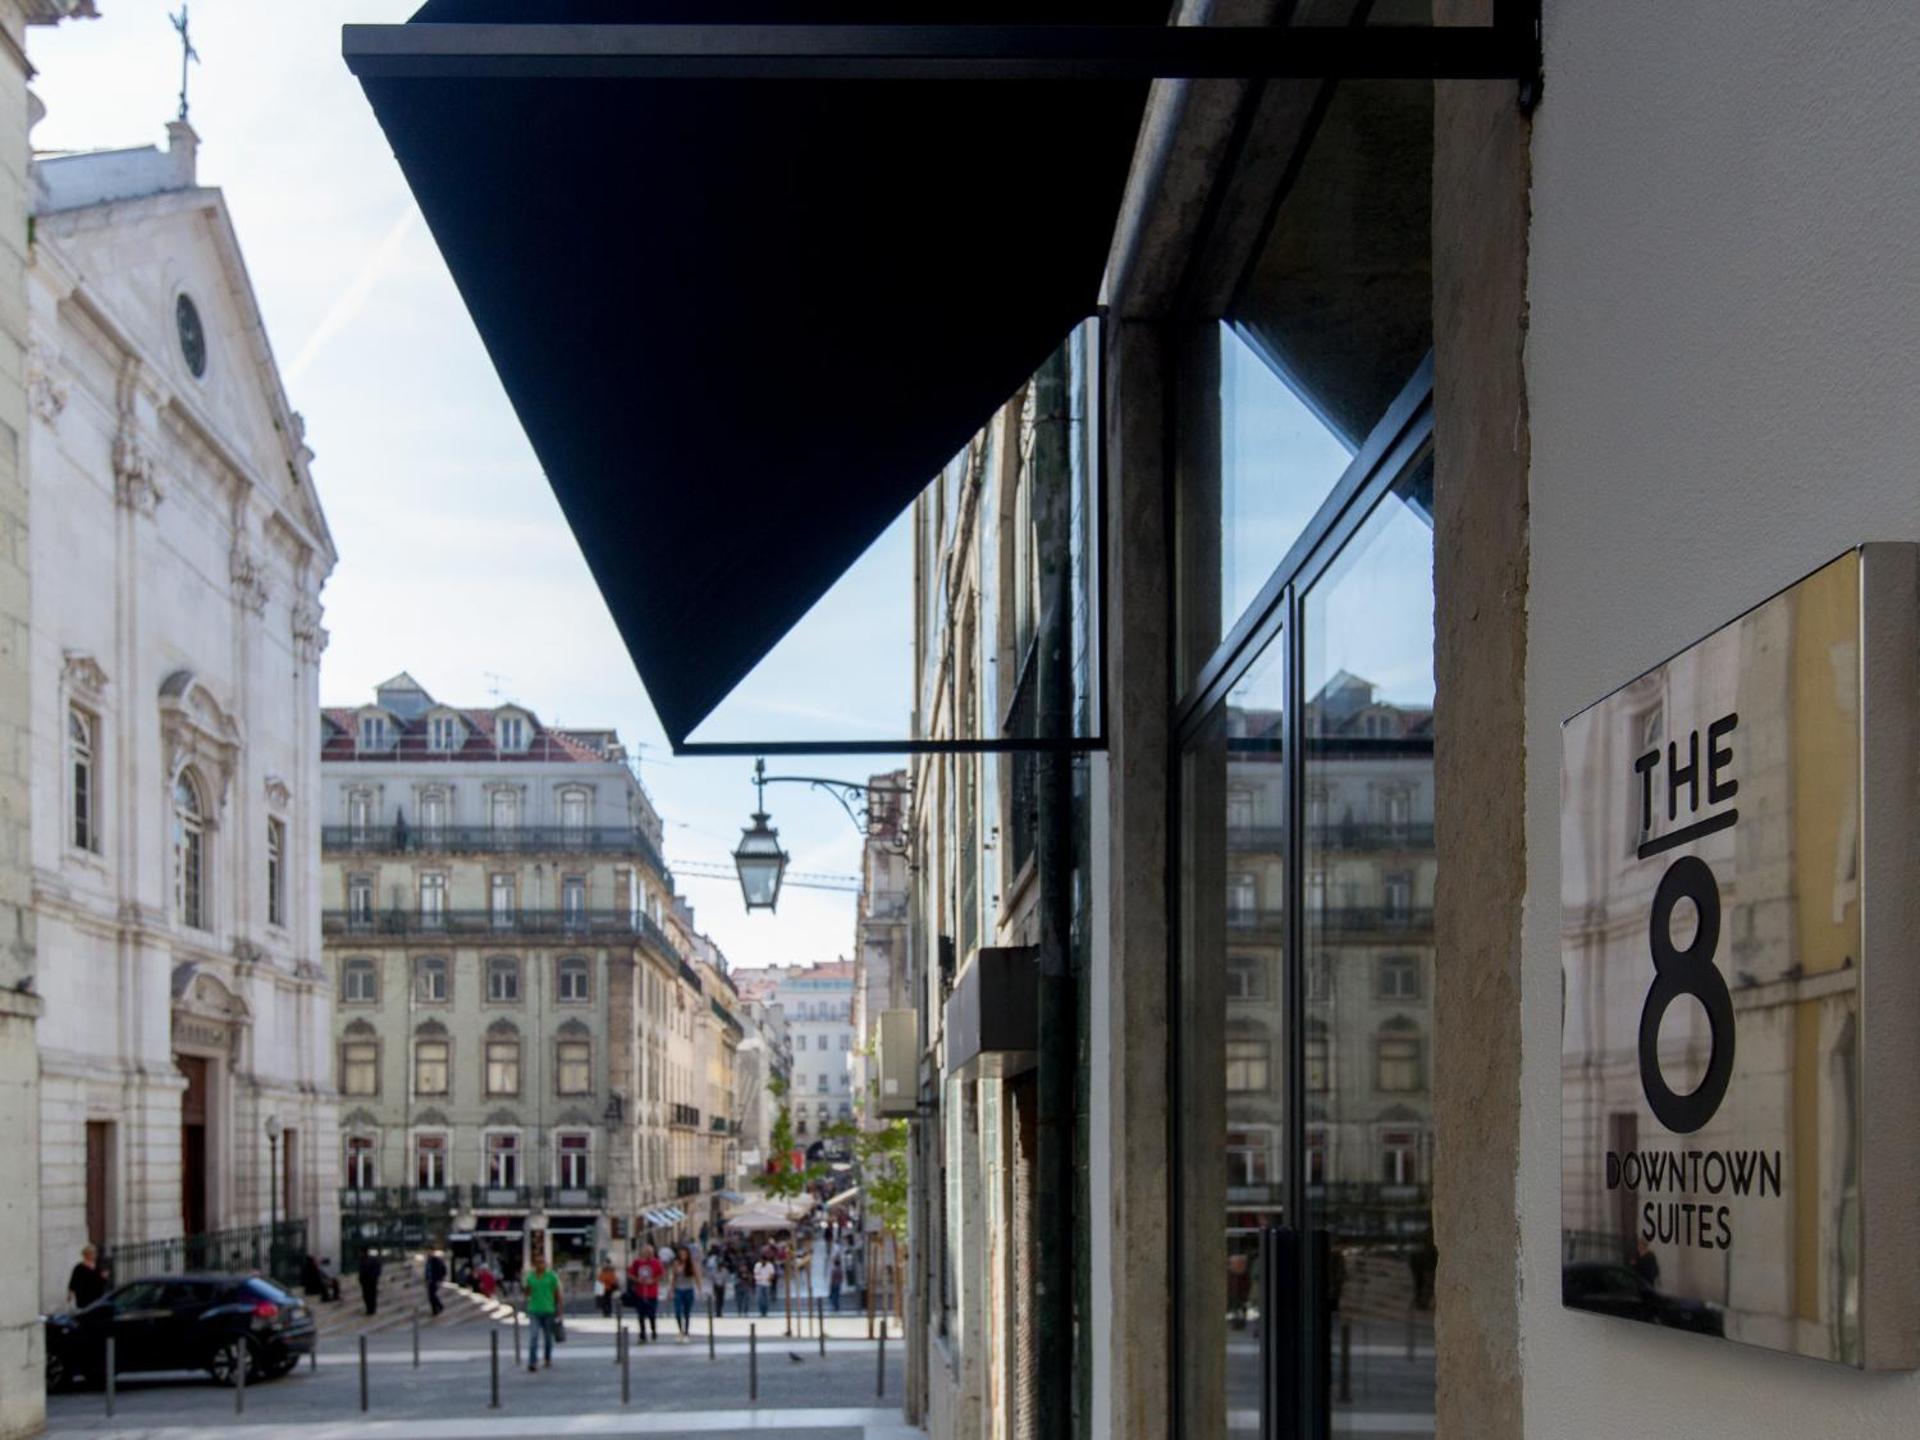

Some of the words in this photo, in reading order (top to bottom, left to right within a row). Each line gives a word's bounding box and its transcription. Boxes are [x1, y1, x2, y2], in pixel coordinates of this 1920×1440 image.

[1635, 712, 1738, 831] THE
[1639, 856, 1735, 1133] 8
[1607, 1151, 1781, 1197] DOWNTOWN
[1643, 1202, 1732, 1250] SUITES
